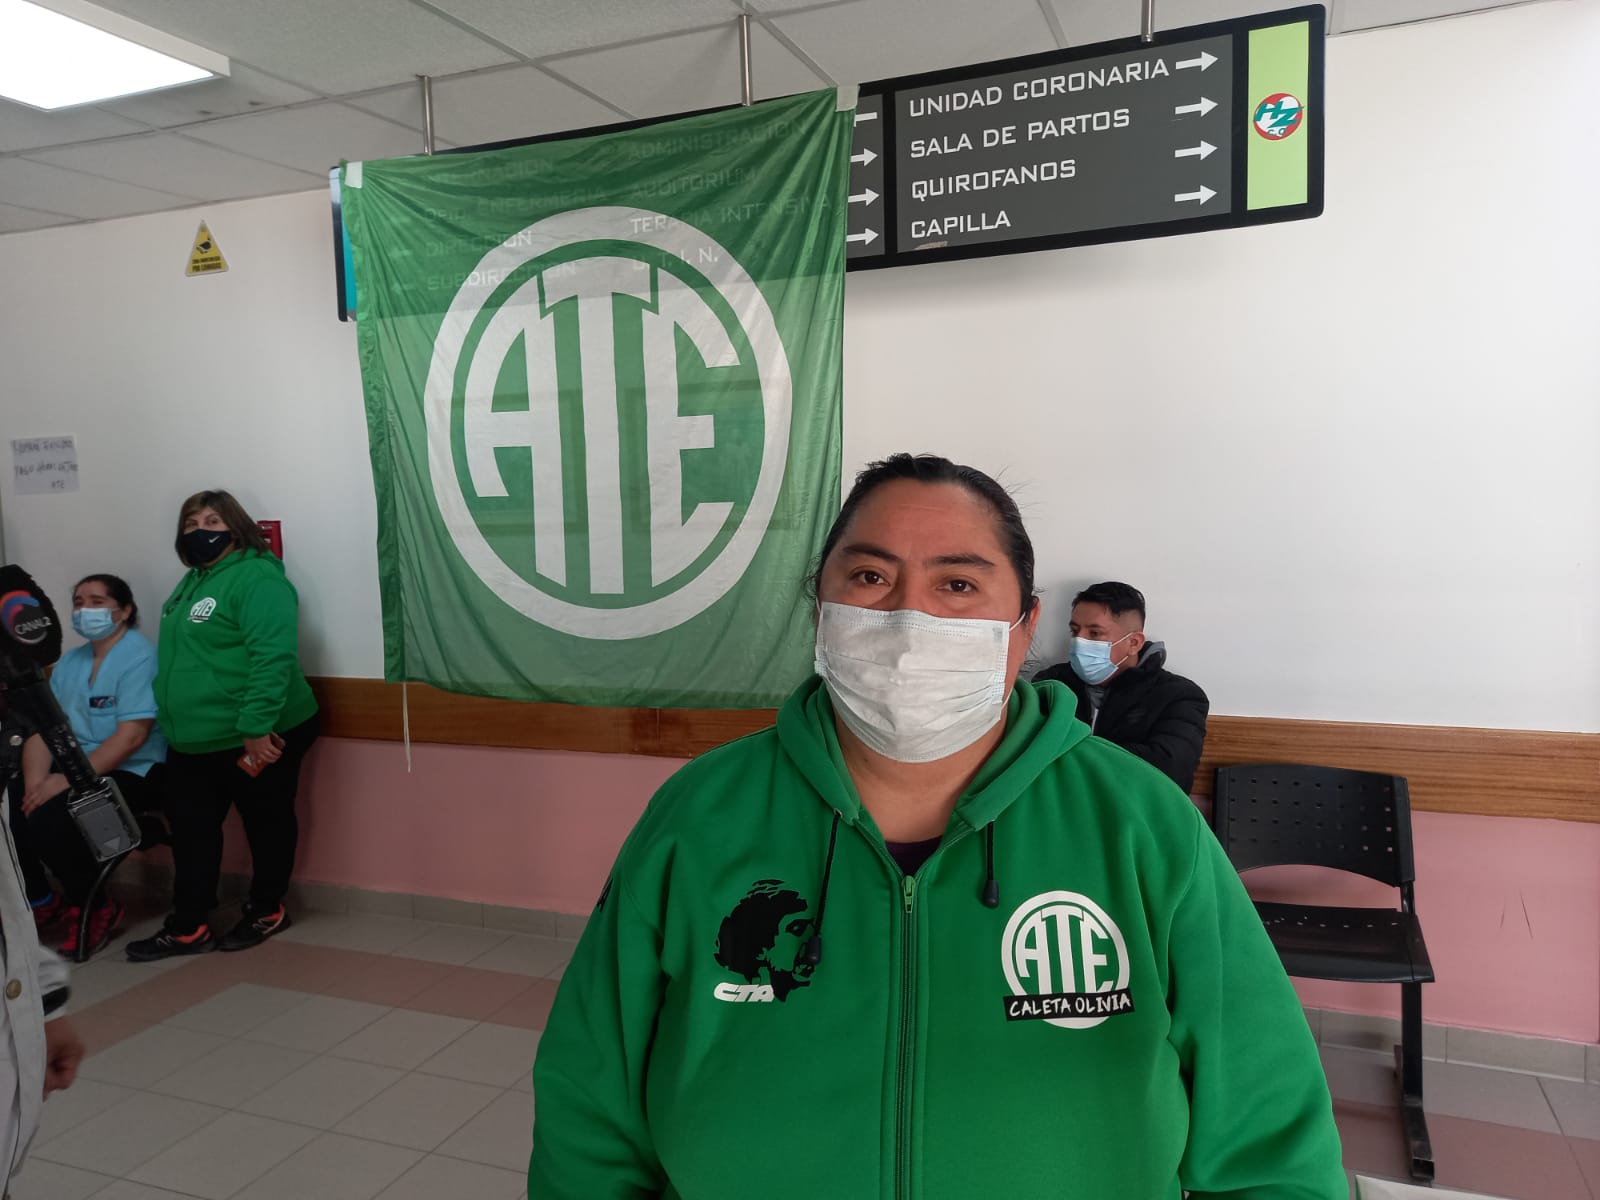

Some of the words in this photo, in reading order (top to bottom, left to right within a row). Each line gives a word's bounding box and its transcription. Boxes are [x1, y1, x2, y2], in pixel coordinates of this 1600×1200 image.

[909, 86, 1002, 117] UNIDAD
[1013, 58, 1170, 101] CORONARIA
[910, 133, 973, 158] SALA
[983, 126, 1017, 147] DE
[1027, 108, 1130, 141] PARTOS
[911, 159, 1077, 202] QUIROFANOS
[911, 210, 1012, 239] CAPILLA
[464, 256, 740, 594] ATE
[1015, 904, 1114, 996] ATE
[713, 982, 775, 1002] CTA
[1009, 997, 1072, 1017] CALETA
[1075, 993, 1132, 1014] OLIVIA
